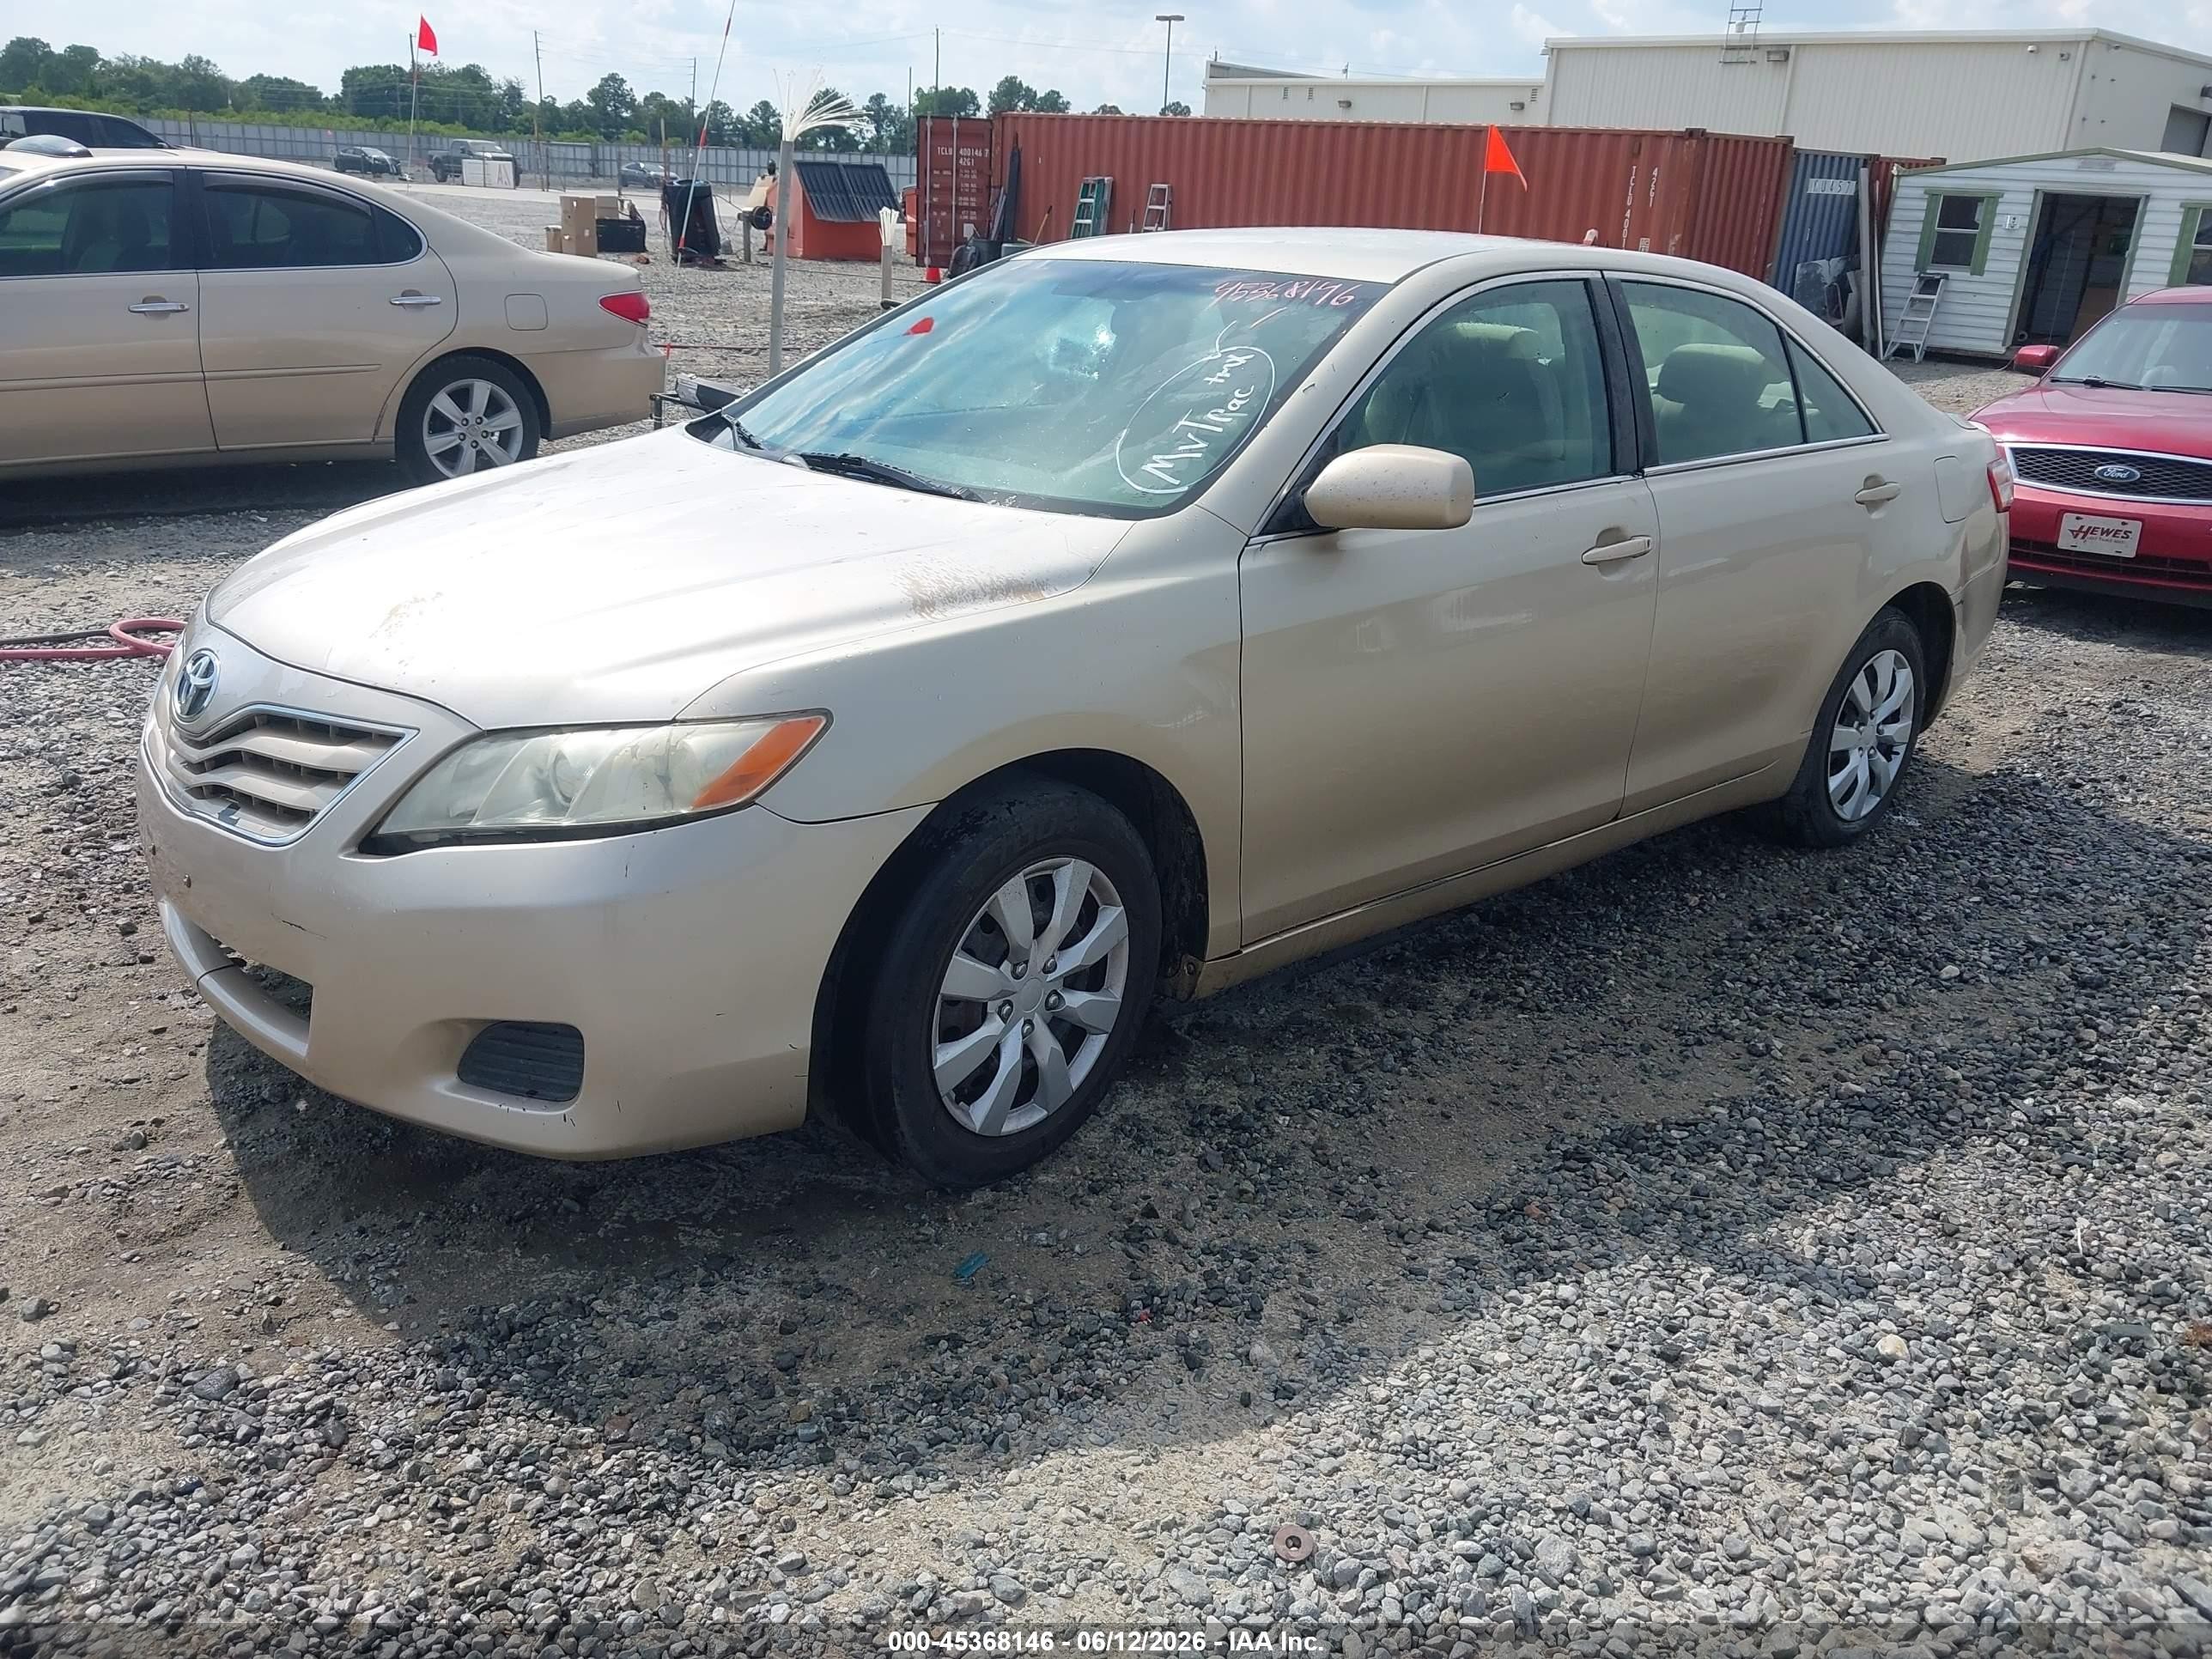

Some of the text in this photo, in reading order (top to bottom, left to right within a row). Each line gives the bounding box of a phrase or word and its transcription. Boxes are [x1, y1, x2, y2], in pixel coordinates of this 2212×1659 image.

[937, 146, 952, 155] TCLU
[959, 148, 982, 157] 400146
[958, 157, 975, 166] 42G1
[1627, 166, 1637, 206] TCLU
[1650, 167, 1658, 208] 42G1
[1205, 280, 1363, 311] 45368146
[2103, 467, 2130, 478] Ford
[2068, 525, 2133, 540] HEWES
